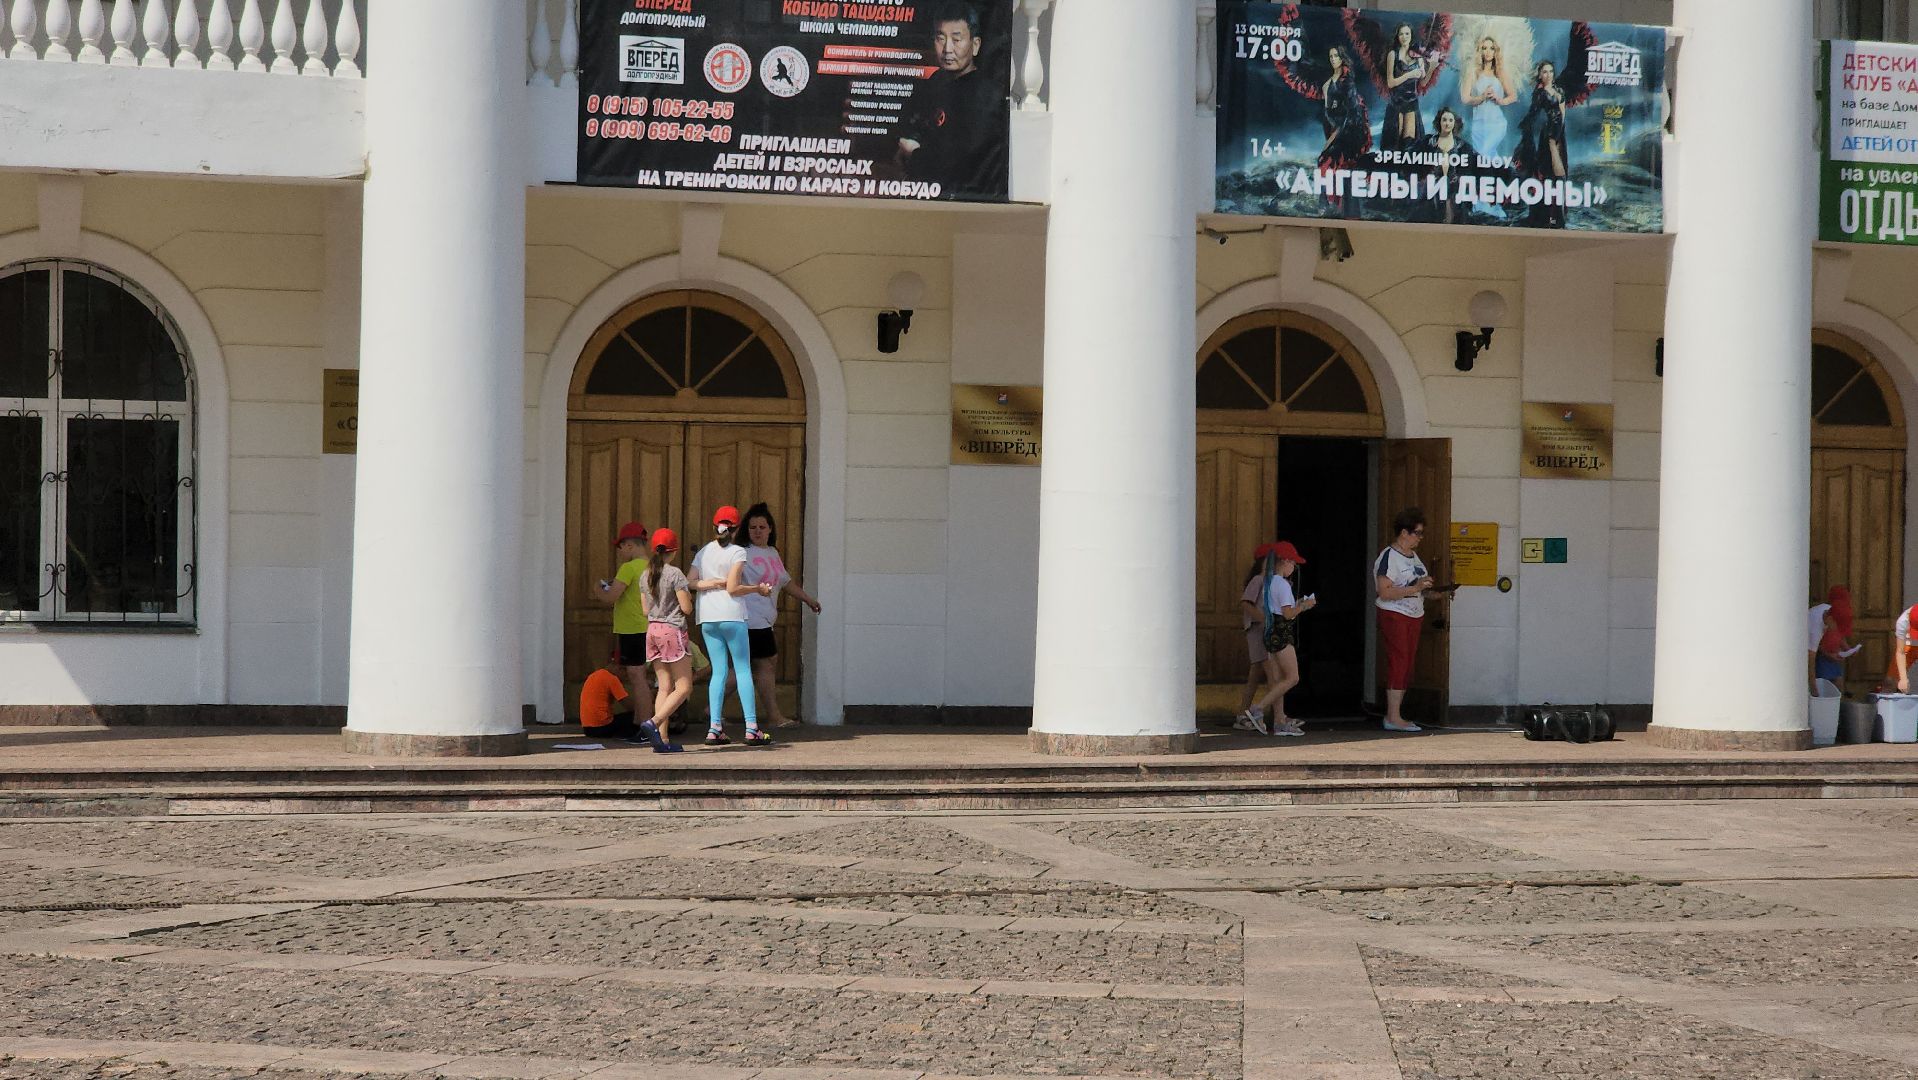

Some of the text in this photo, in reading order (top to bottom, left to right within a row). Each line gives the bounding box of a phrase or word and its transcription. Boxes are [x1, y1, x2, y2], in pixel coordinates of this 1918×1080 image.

[620, 11, 706, 28] ДОЛГОПРУДНЫЙ
[783, 0, 914, 22] КОБУДО ТАЦУДЗИН
[800, 21, 899, 37] ШКОЛА ЧЕМПИОНОВ
[1235, 23, 1301, 38] 13 ОКТЯБРЯ
[874, 51, 922, 60] РУКОВОДИТЕЛЬ
[1235, 36, 1302, 62] 17:00
[1843, 73, 1893, 92] КЛУБ
[587, 94, 734, 120] 8 (915) 105-22-55
[1841, 97, 1918, 113] на базе Дом
[586, 118, 732, 143] 8 (909) 695-82-46
[1841, 117, 1908, 130] ПРИГЛАШАЕТ
[739, 134, 851, 155] ПРИГЛАШАЕМ
[1250, 138, 1286, 159] 16+
[1841, 135, 1918, 153] ДЕТЕЙ ОТ
[713, 151, 874, 175] ДЕТЕЙ И ВЗРОСЛЫХ
[1374, 150, 1513, 169] ЗРЕЛИЩНОЕ ШОУ
[1840, 167, 1864, 182] на
[638, 169, 942, 200] НА ТРЕНИРОВКИ ПО КАРАТЭ И КОБУДО
[1276, 168, 1608, 208] «АНГЕЛЫ И ДЕМОНЫ»
[1529, 453, 1606, 472] «ВПЕРЁД»
